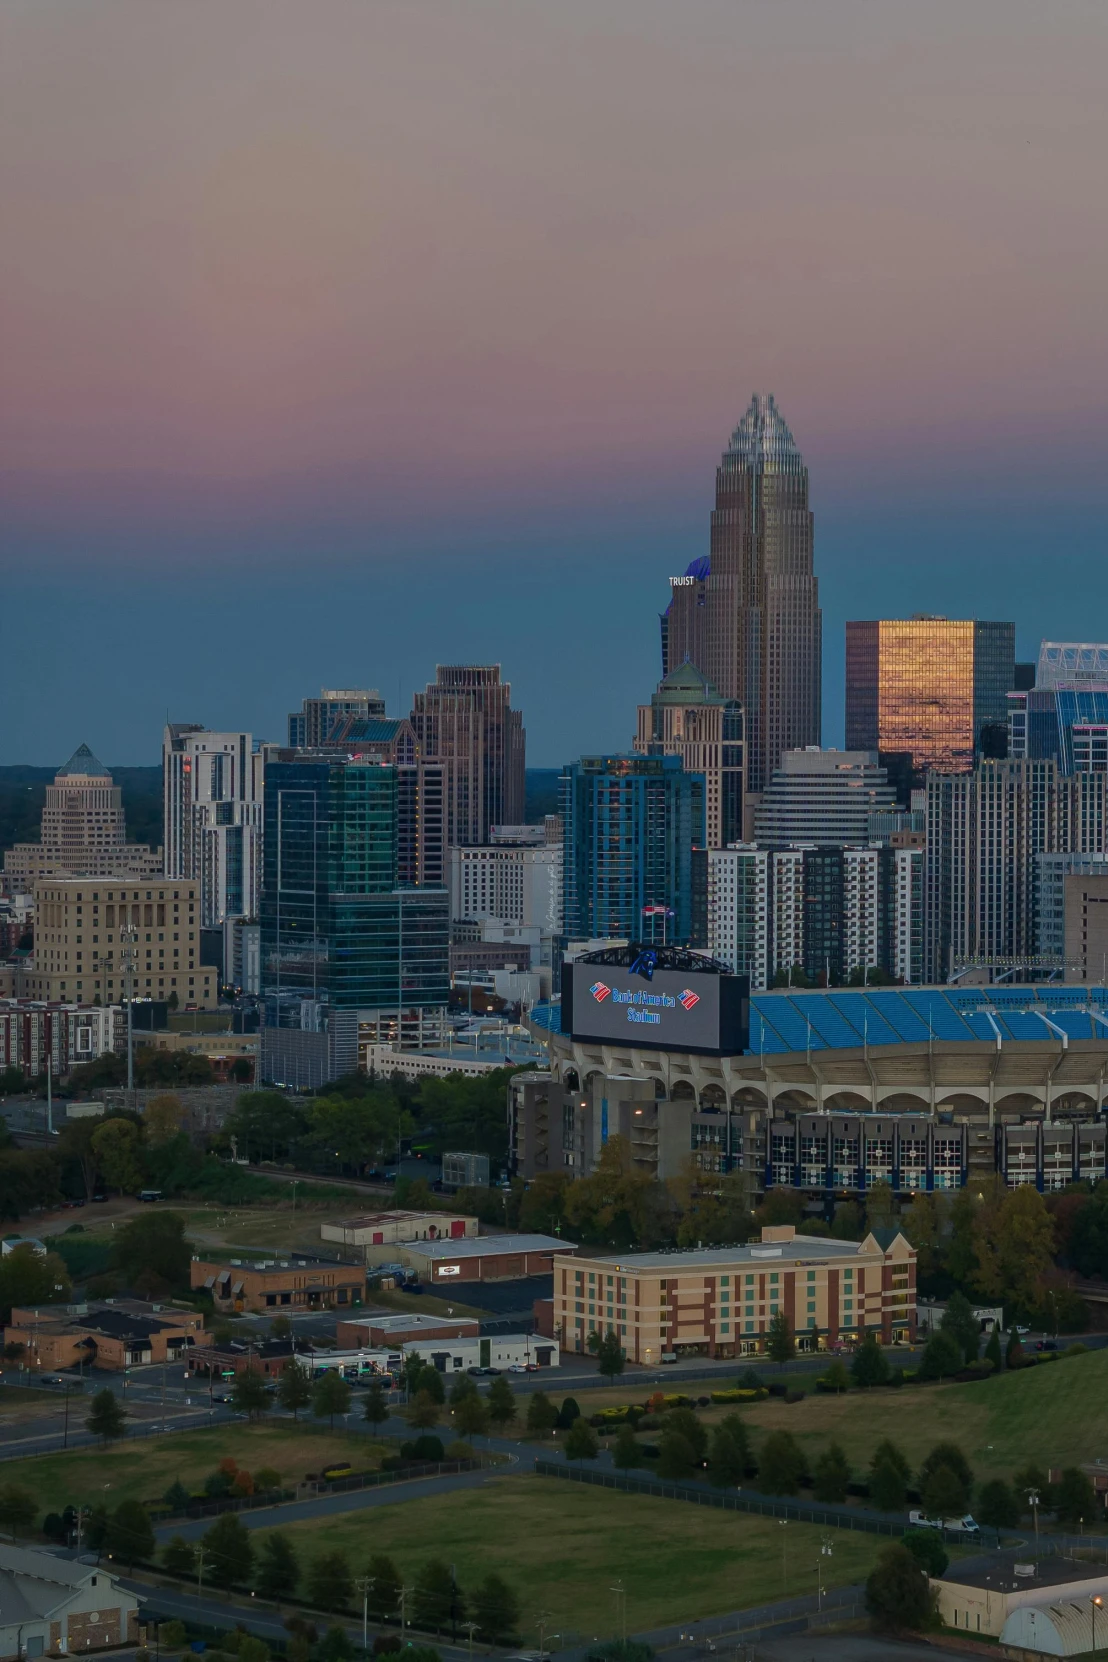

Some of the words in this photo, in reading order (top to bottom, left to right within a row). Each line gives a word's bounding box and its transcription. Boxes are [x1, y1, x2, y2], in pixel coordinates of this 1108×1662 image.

[669, 576, 694, 586] TRUIST
[612, 988, 633, 1004] Bank
[633, 991, 642, 1005] of
[642, 991, 676, 1008] America
[627, 1007, 661, 1024] Stadium
